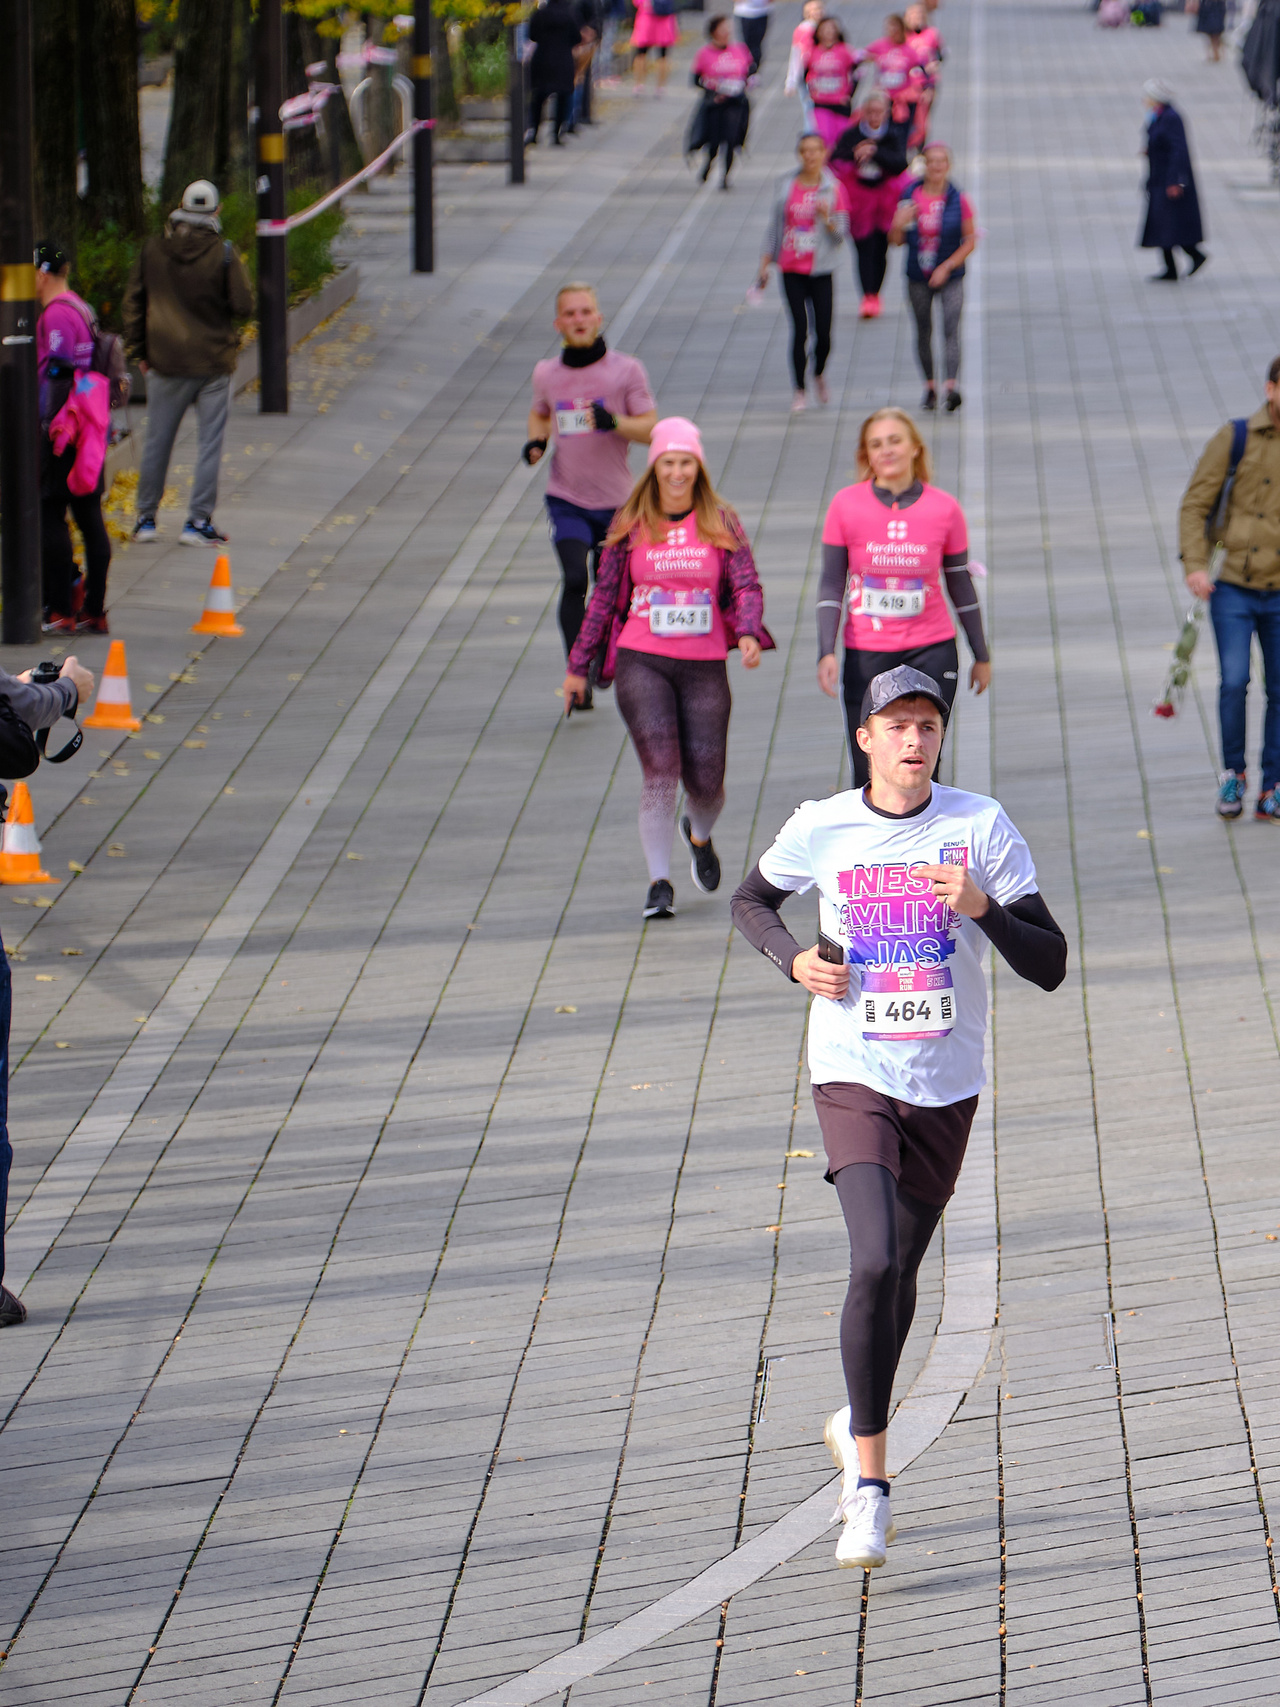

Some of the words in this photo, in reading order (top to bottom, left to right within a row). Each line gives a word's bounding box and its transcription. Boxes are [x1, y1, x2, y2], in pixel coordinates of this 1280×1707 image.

[646, 546, 708, 560] Kardiolitos
[865, 541, 928, 555] Kardiolitos
[654, 558, 702, 571] Klinikos
[872, 554, 921, 567] Klinikos
[879, 595, 907, 611] 419
[667, 610, 695, 626] 543
[851, 861, 934, 900] NES
[865, 937, 941, 973] JAS
[899, 977, 914, 985] PINK
[885, 1000, 931, 1022] 464
